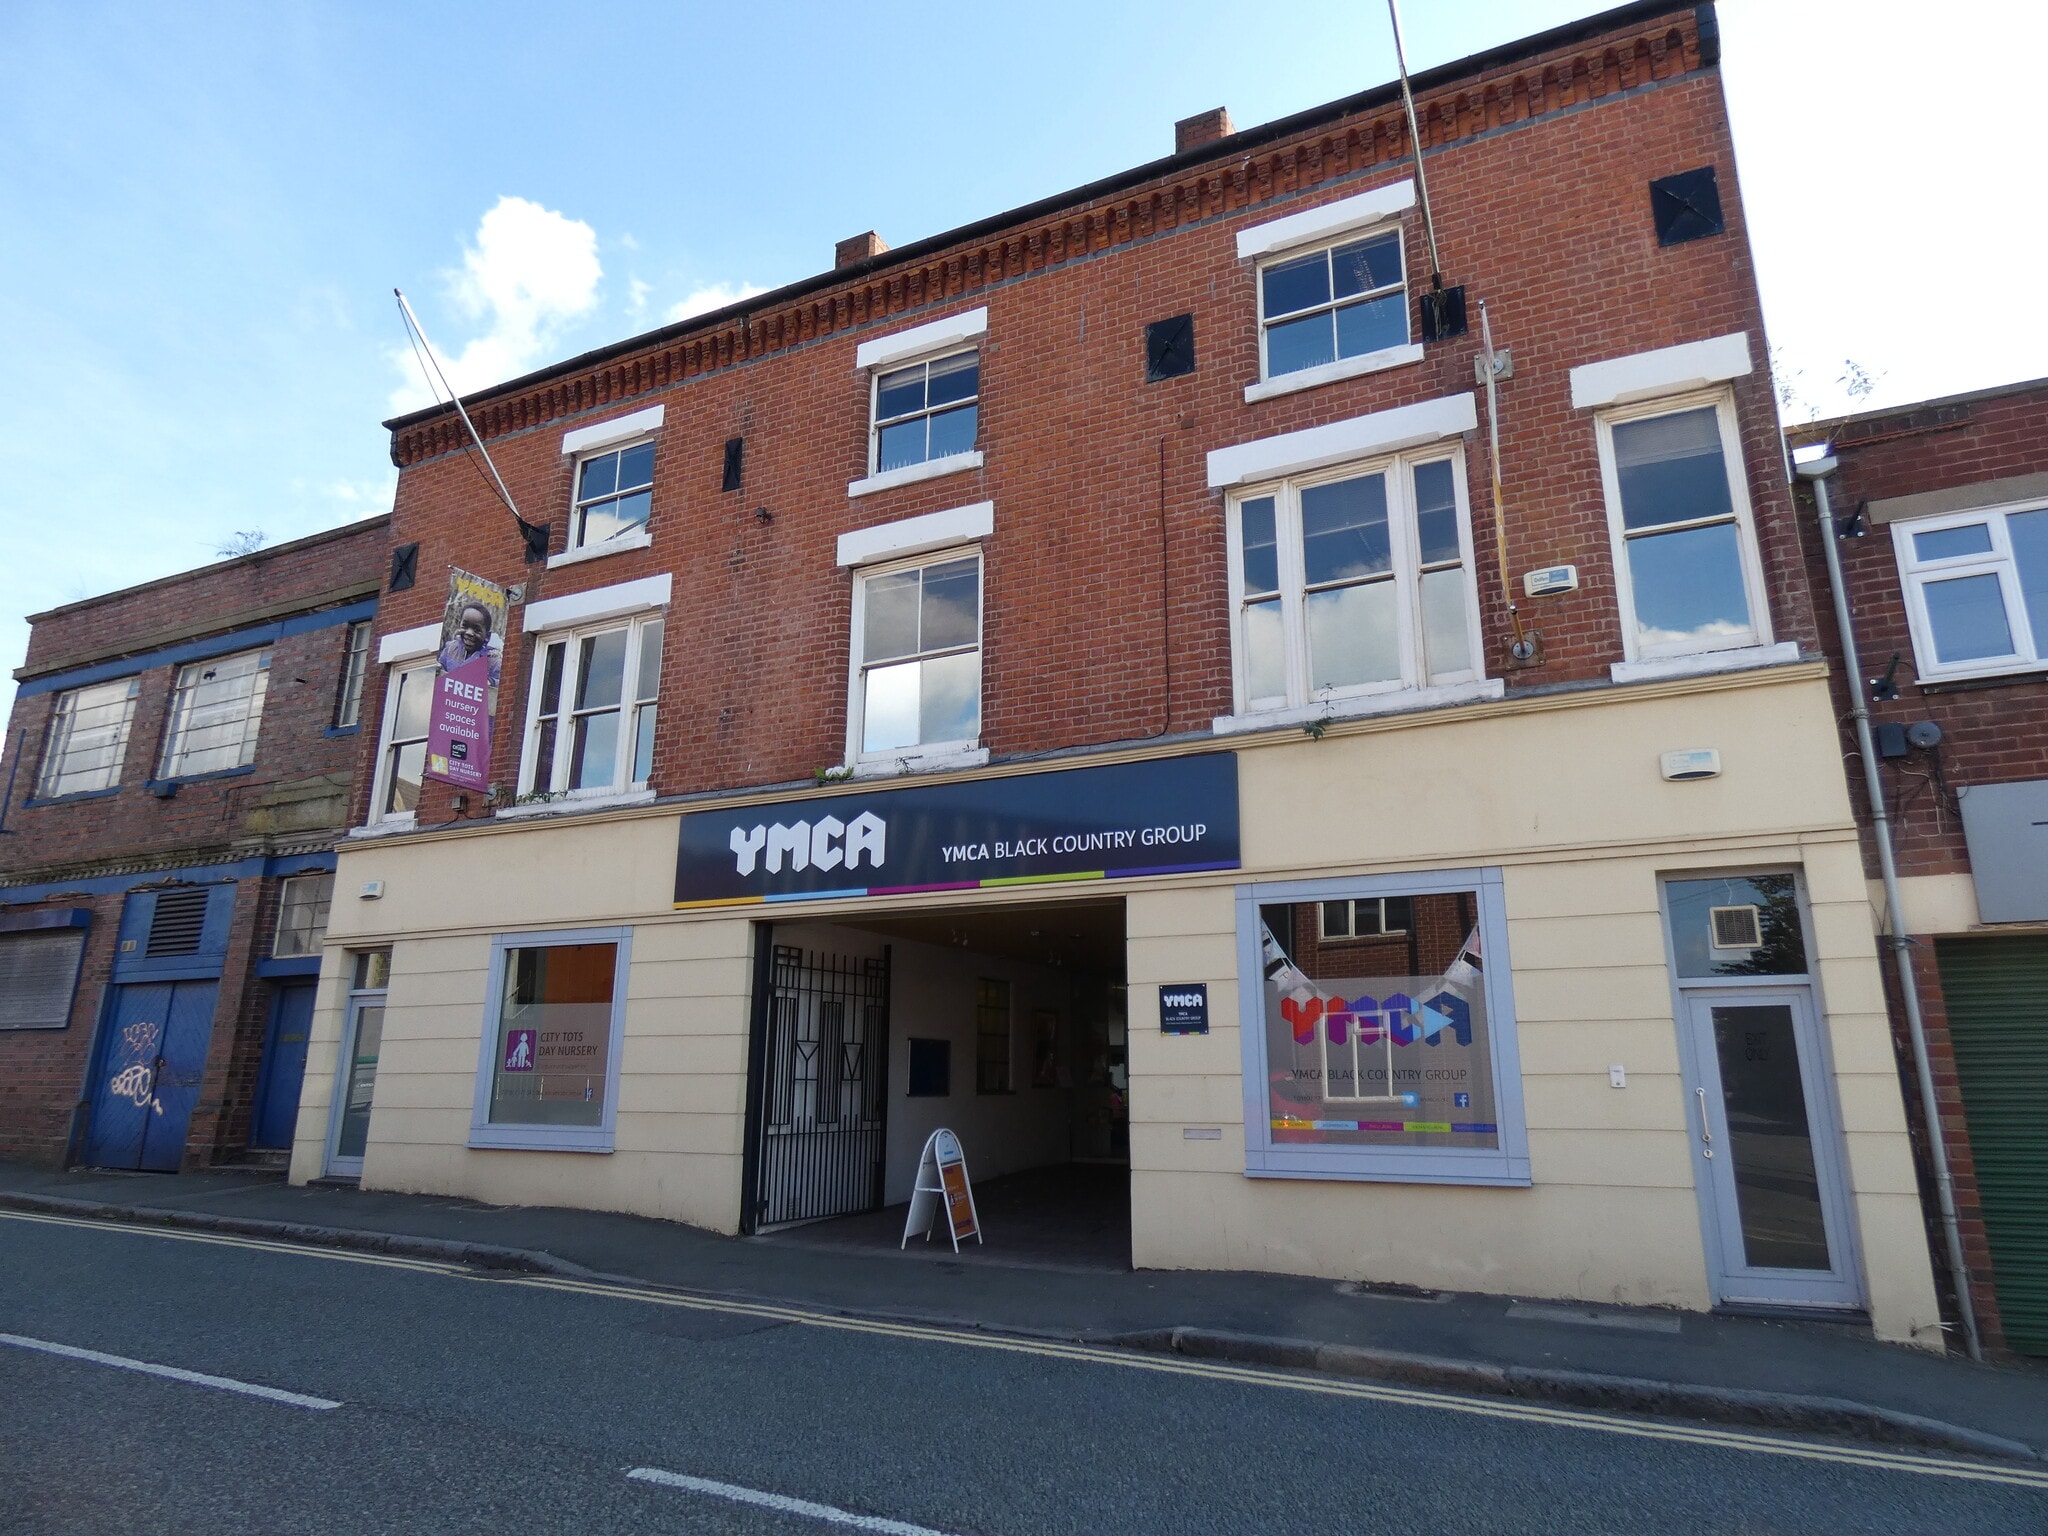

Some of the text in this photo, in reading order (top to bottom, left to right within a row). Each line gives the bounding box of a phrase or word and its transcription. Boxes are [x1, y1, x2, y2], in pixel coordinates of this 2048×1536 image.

[456, 577, 505, 608] YMCA
[444, 677, 484, 702] FREE
[445, 699, 479, 715] nursery
[445, 712, 476, 726] spaces
[440, 723, 480, 740] available
[460, 768, 482, 778] NURSERY
[729, 810, 887, 877] YMCA
[941, 823, 1207, 863] YMCA BLACK COUNTRY GROUP
[1163, 993, 1203, 1008] YMCA
[1280, 990, 1473, 1047] YMCA
[541, 1032, 583, 1042] CITY TOTS
[539, 1045, 598, 1056] DAY NURSERY
[1291, 1069, 1467, 1081] YMCA BLACK COUNTRY GROUP
